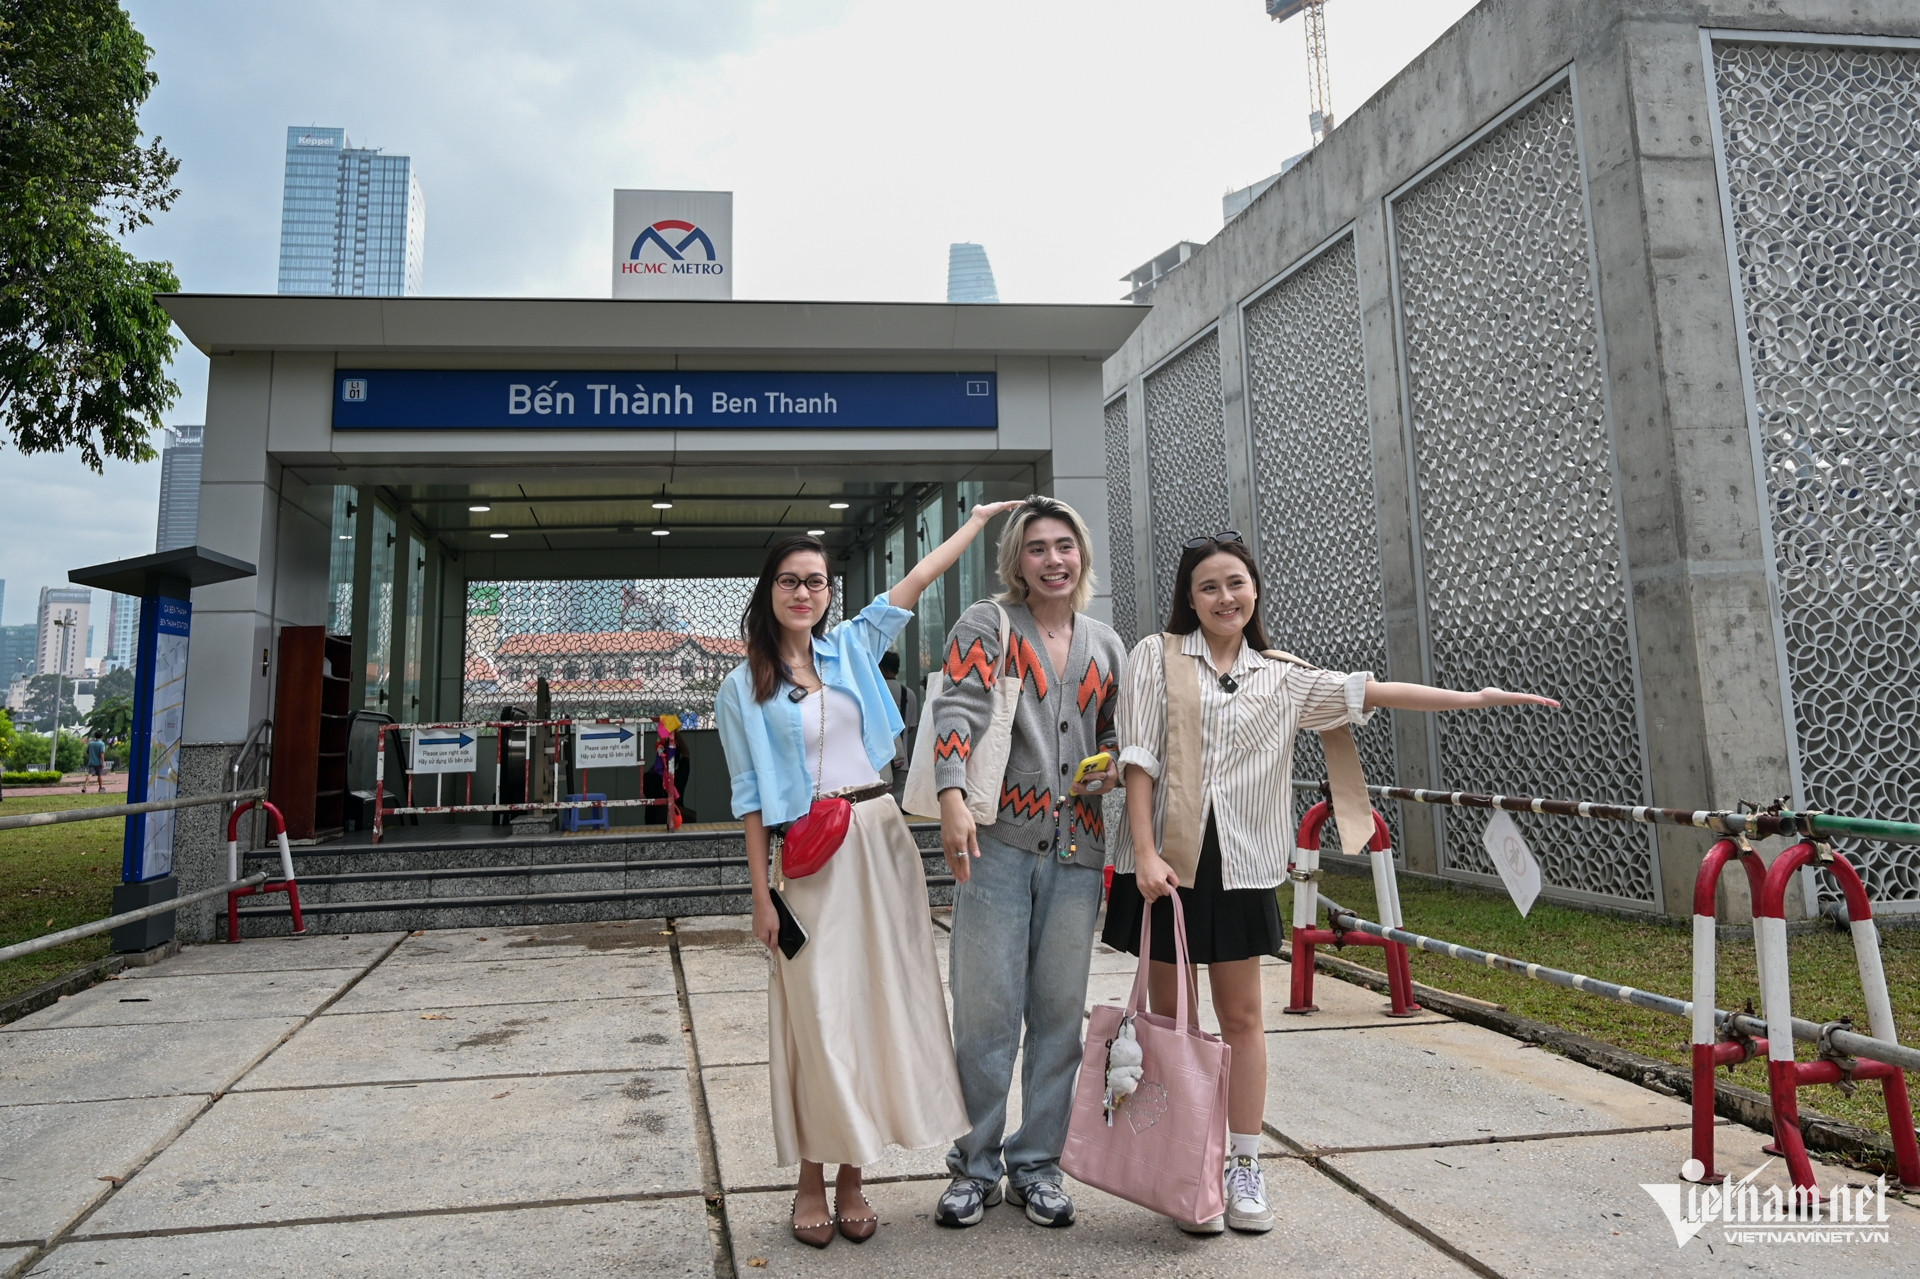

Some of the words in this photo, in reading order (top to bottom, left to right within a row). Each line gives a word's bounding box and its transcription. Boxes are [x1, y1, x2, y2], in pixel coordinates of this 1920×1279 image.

[298, 134, 333, 146] Keppel
[622, 263, 667, 274] HCMC
[672, 263, 723, 275] METRO
[349, 389, 360, 399] 01
[508, 380, 575, 415] Bến
[586, 384, 693, 415] Thành
[711, 392, 757, 414] Ben
[764, 392, 837, 414] Thanh
